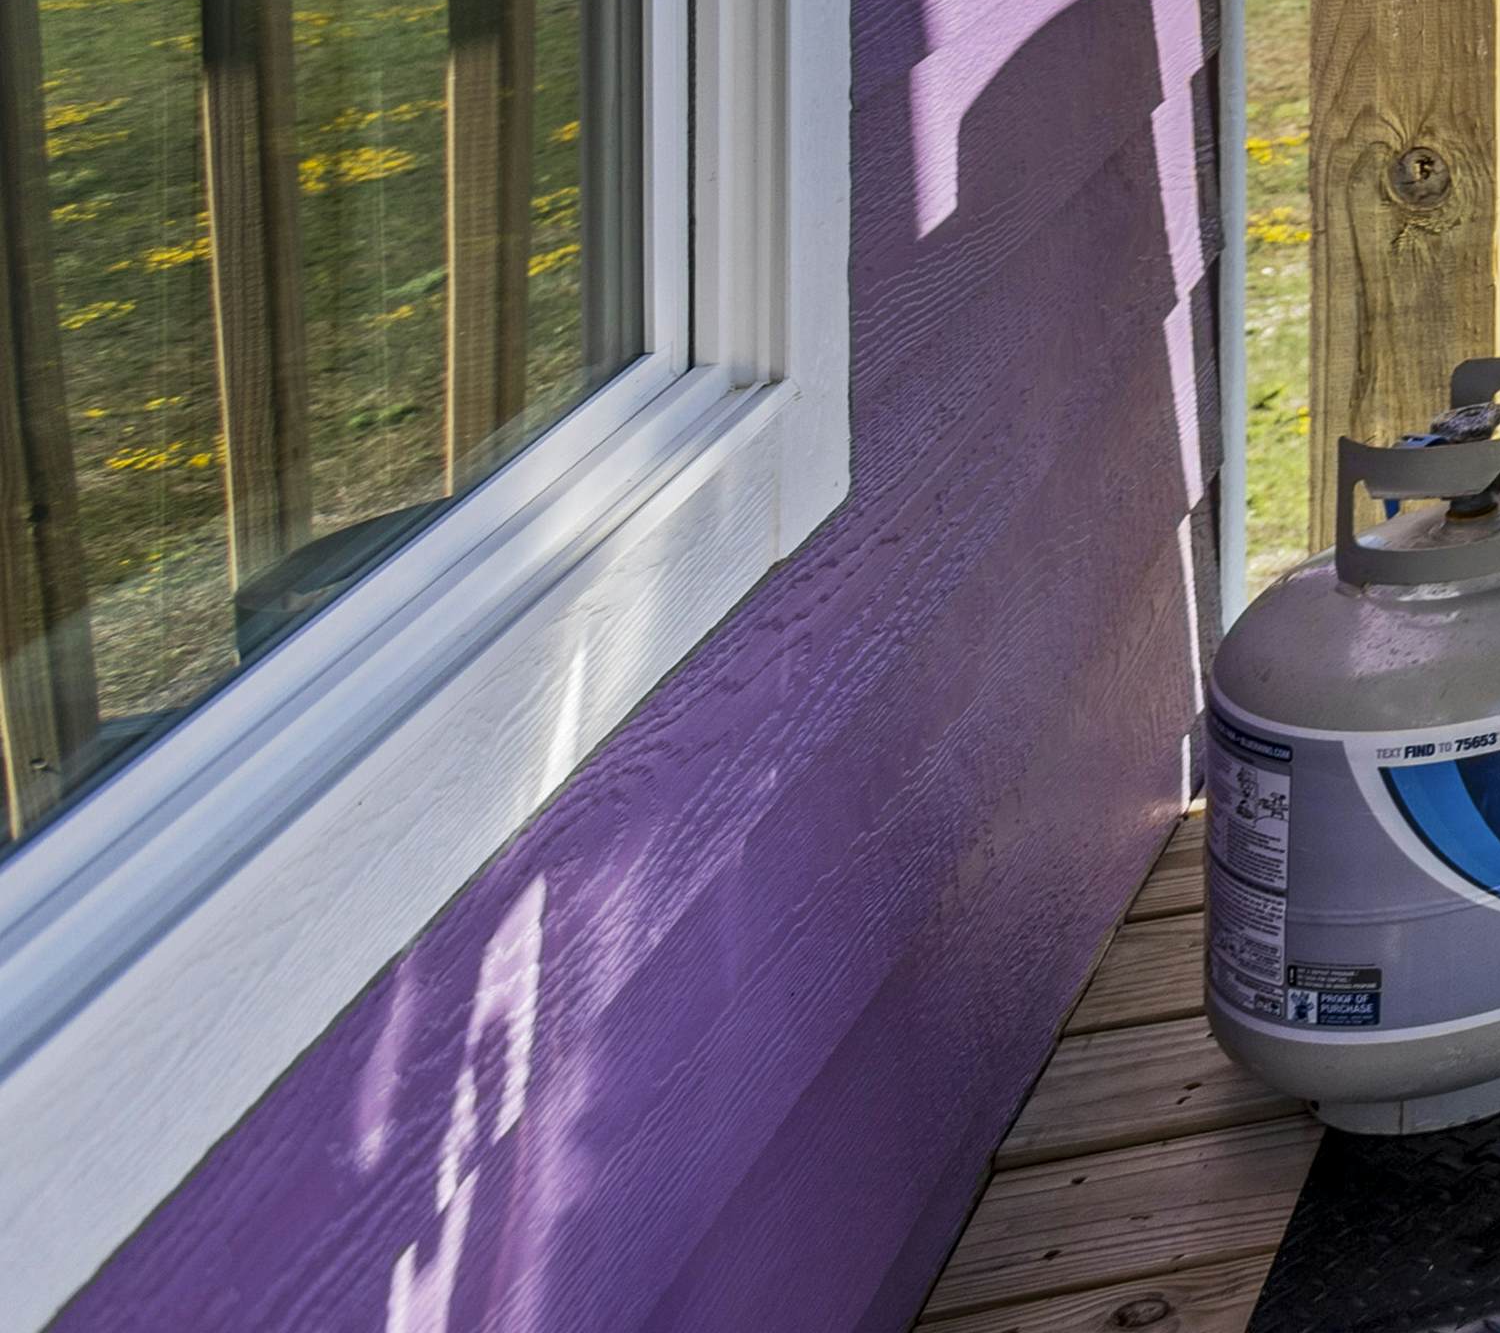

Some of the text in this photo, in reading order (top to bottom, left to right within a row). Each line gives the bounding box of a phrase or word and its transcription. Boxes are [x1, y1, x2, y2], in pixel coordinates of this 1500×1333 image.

[1376, 747, 1402, 759] TEXT
[1404, 743, 1436, 759] FIND
[1438, 743, 1453, 753] TO
[1454, 732, 1498, 752] 75653
[1320, 994, 1369, 1004] PROOF OF
[1320, 1003, 1373, 1014] PURCHASE
